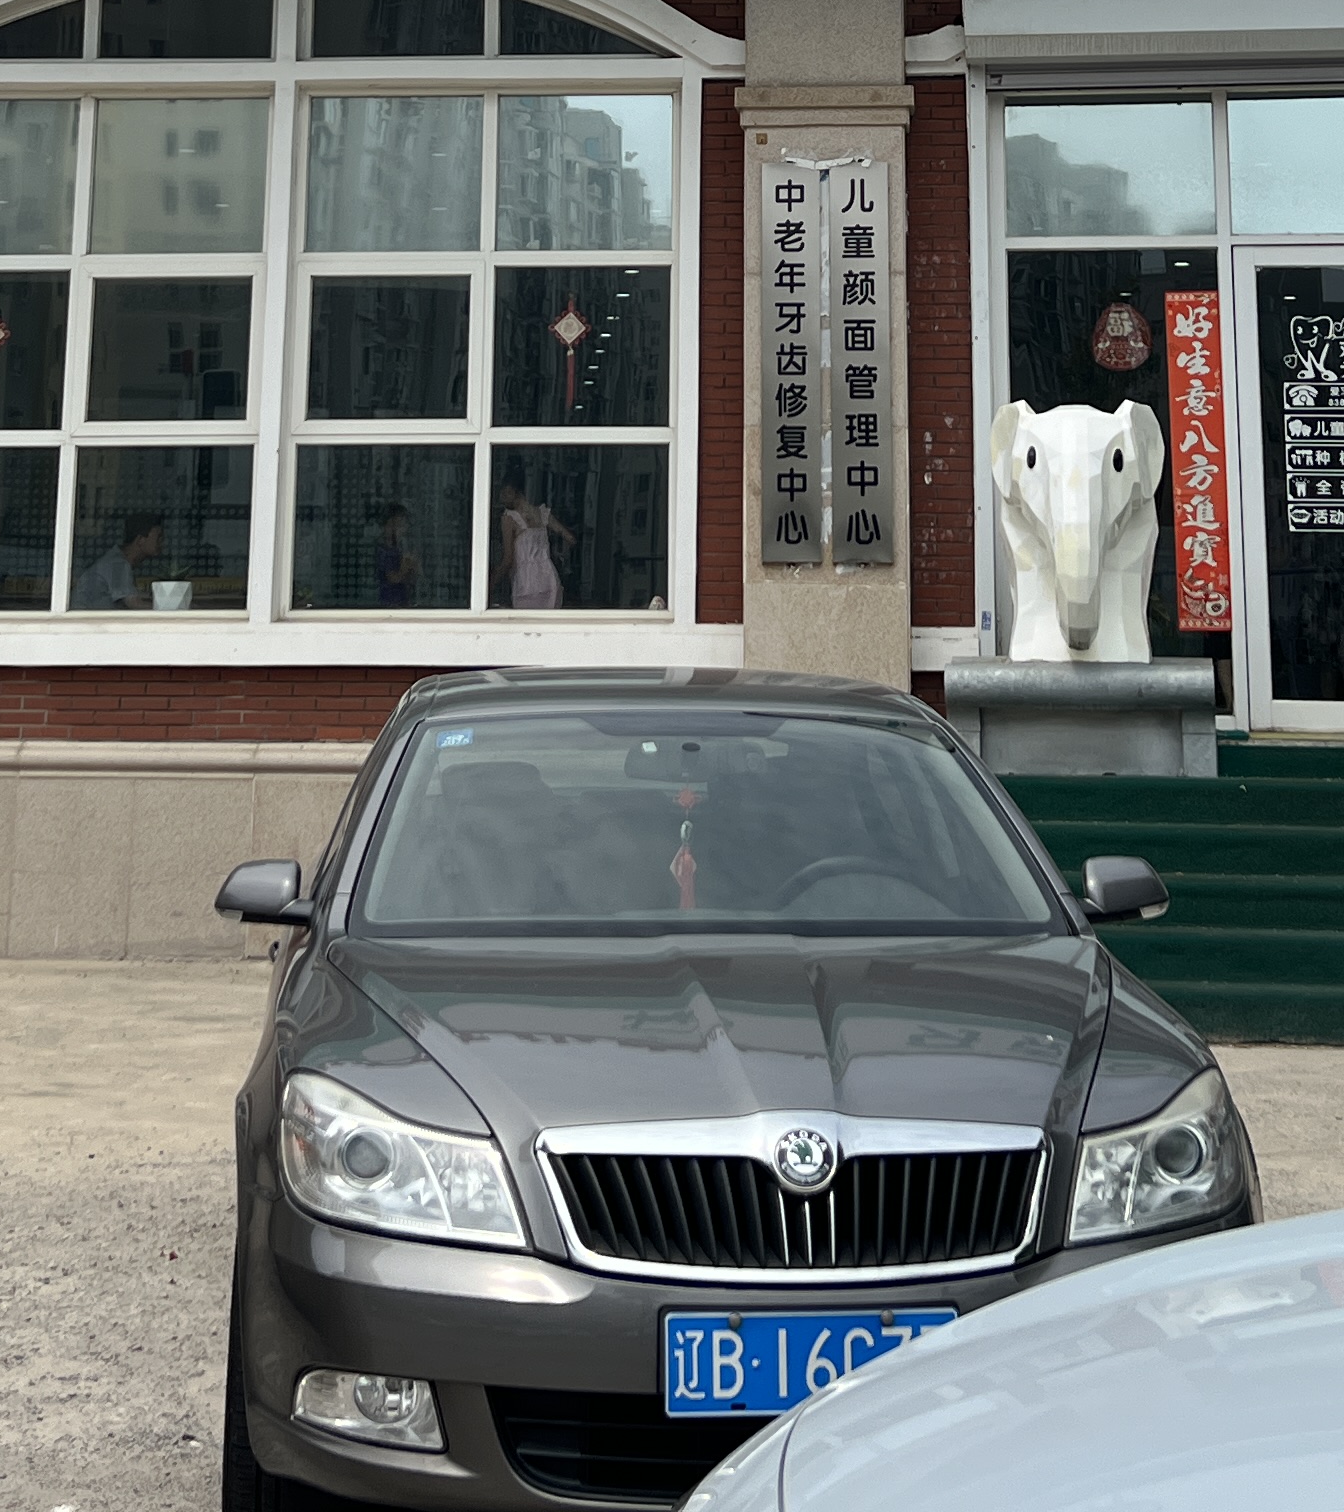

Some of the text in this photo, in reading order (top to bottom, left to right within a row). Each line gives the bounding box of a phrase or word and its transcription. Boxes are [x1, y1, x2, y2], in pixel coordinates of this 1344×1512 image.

[773, 178, 809, 545] 中老年牙齿修复中心
[841, 177, 882, 545] 儿童颜面管理中心
